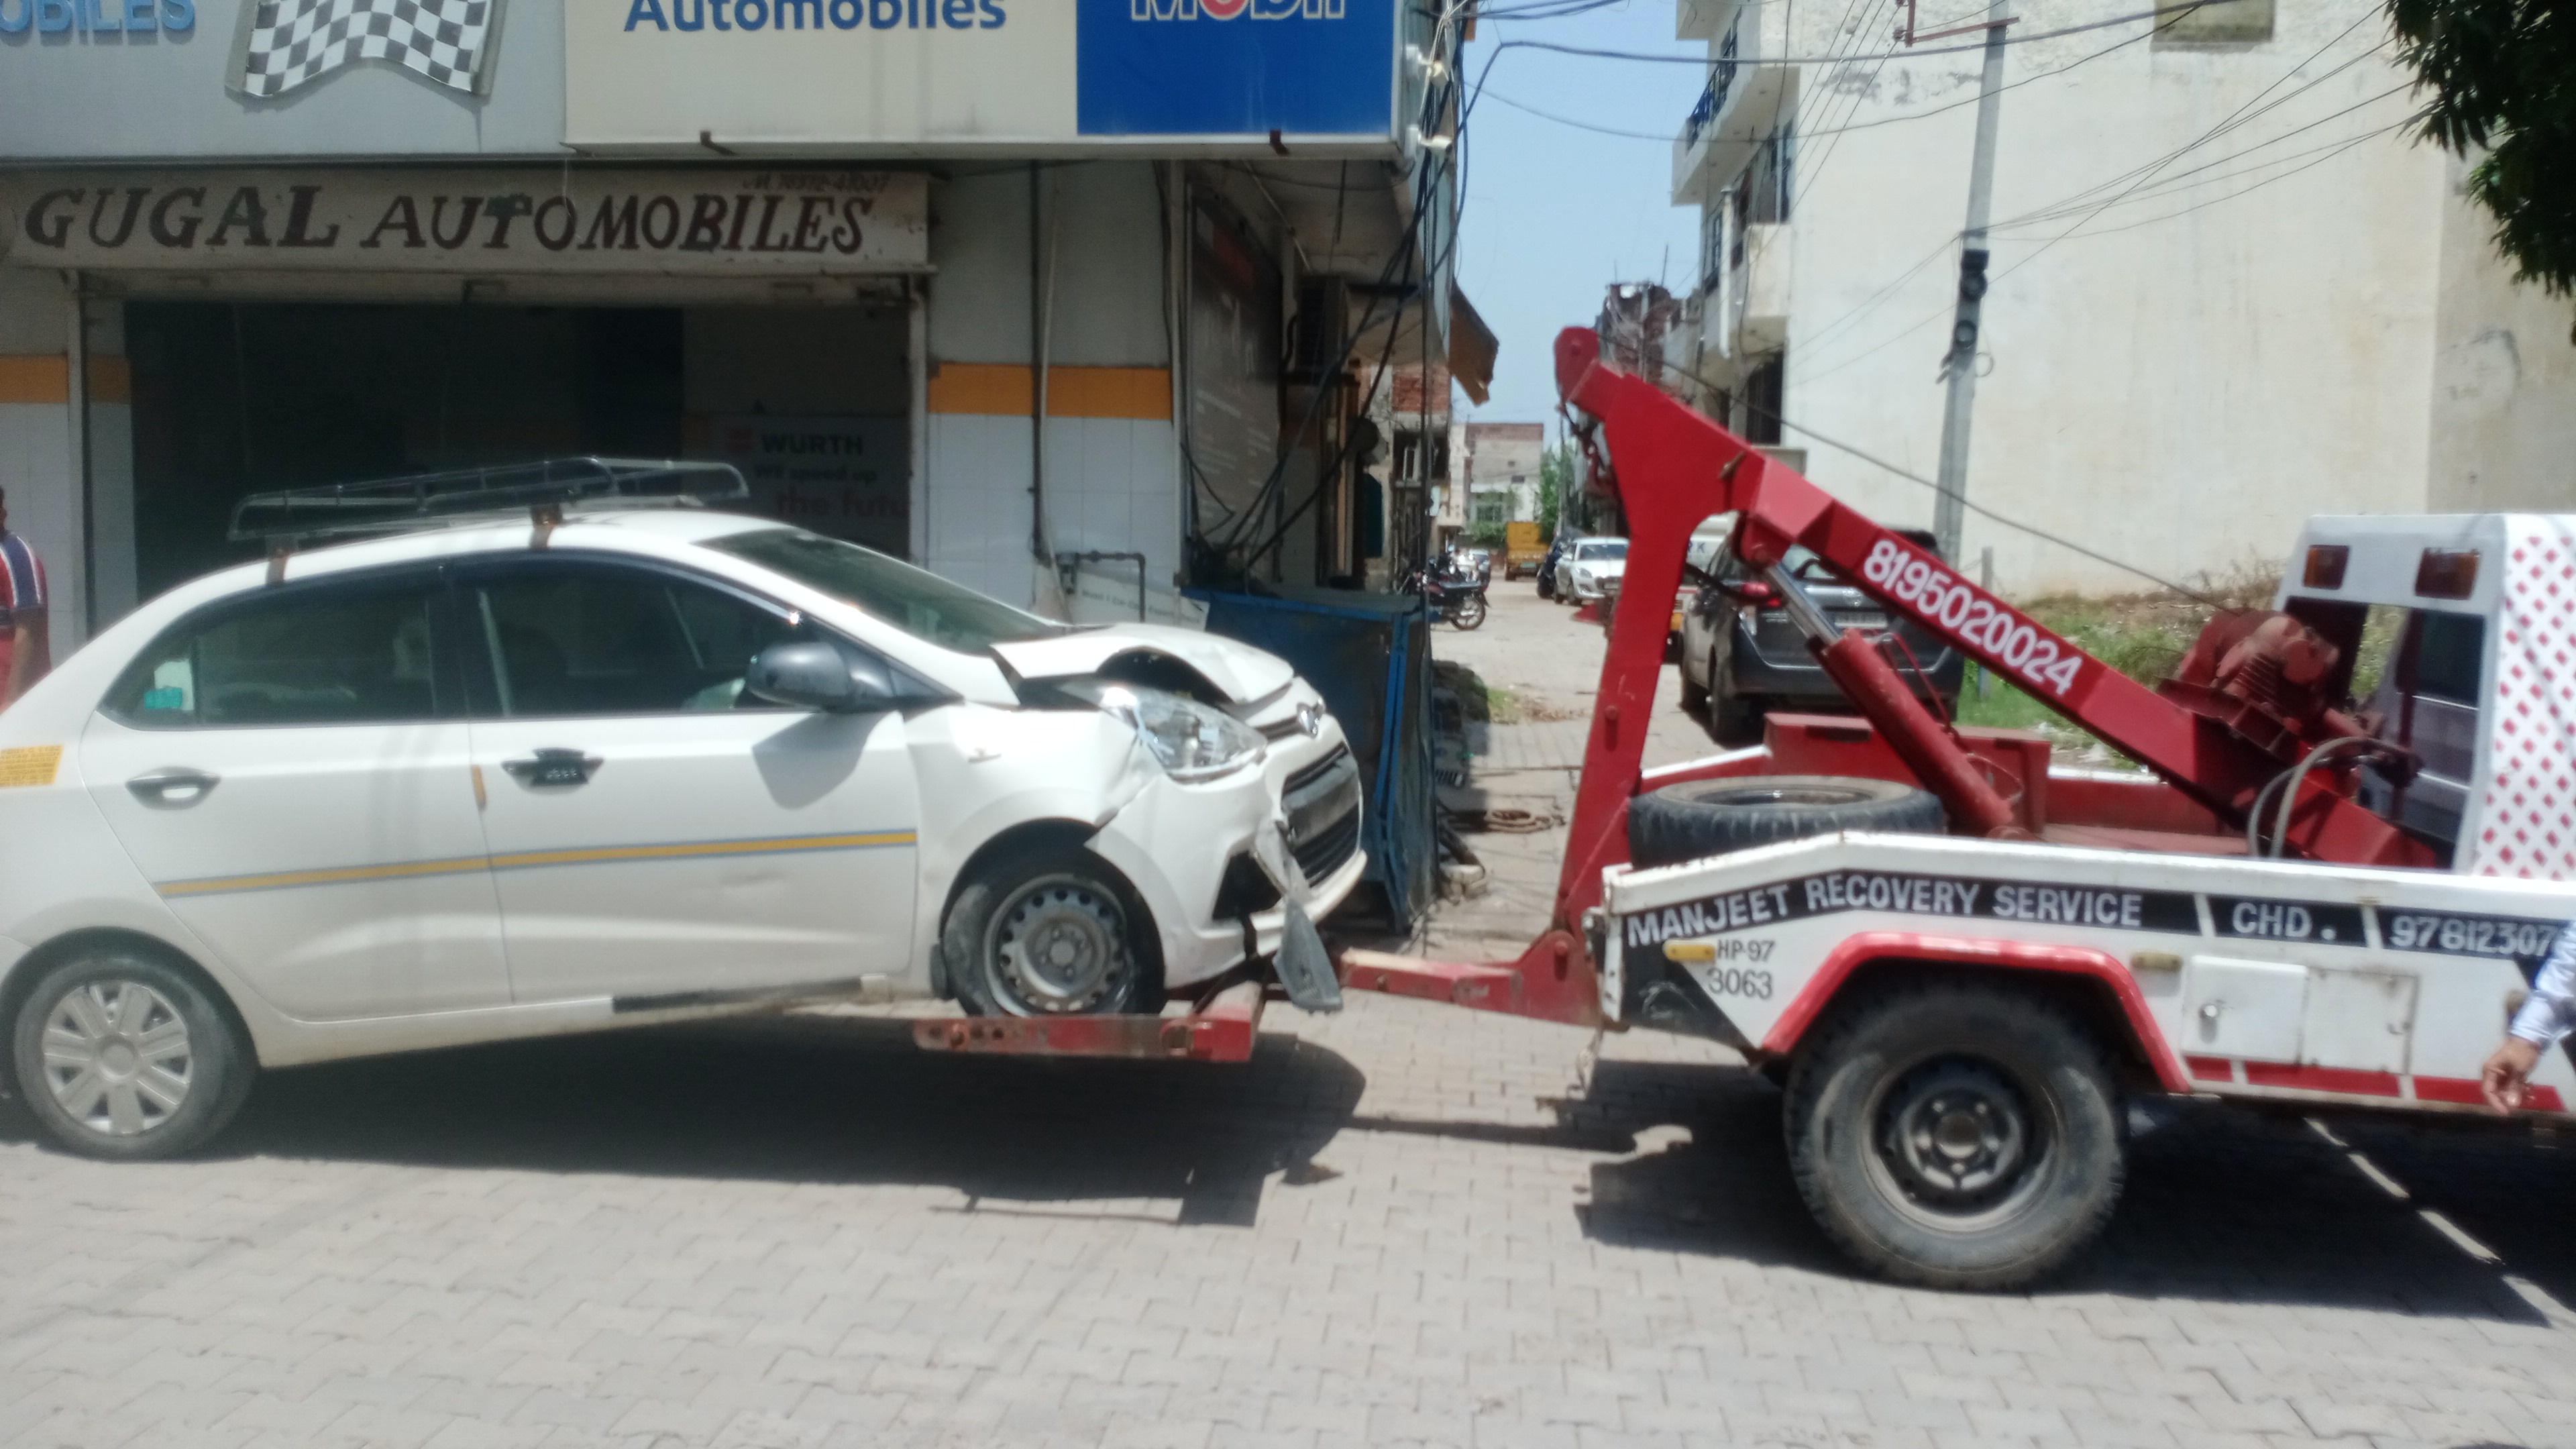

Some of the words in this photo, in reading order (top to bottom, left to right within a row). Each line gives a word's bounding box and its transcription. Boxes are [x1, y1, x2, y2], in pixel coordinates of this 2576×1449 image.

[625, 0, 1006, 32] Automobiles
[25, 186, 339, 248] GUGAL
[359, 194, 876, 254] AUTOMOBILES
[1864, 539, 2082, 695] 8195020024
[1627, 884, 1789, 948] MANJEET
[1805, 875, 1980, 914] RECOVERY
[1993, 885, 2143, 927] SERVICE
[1707, 967, 1772, 1000] 3063
